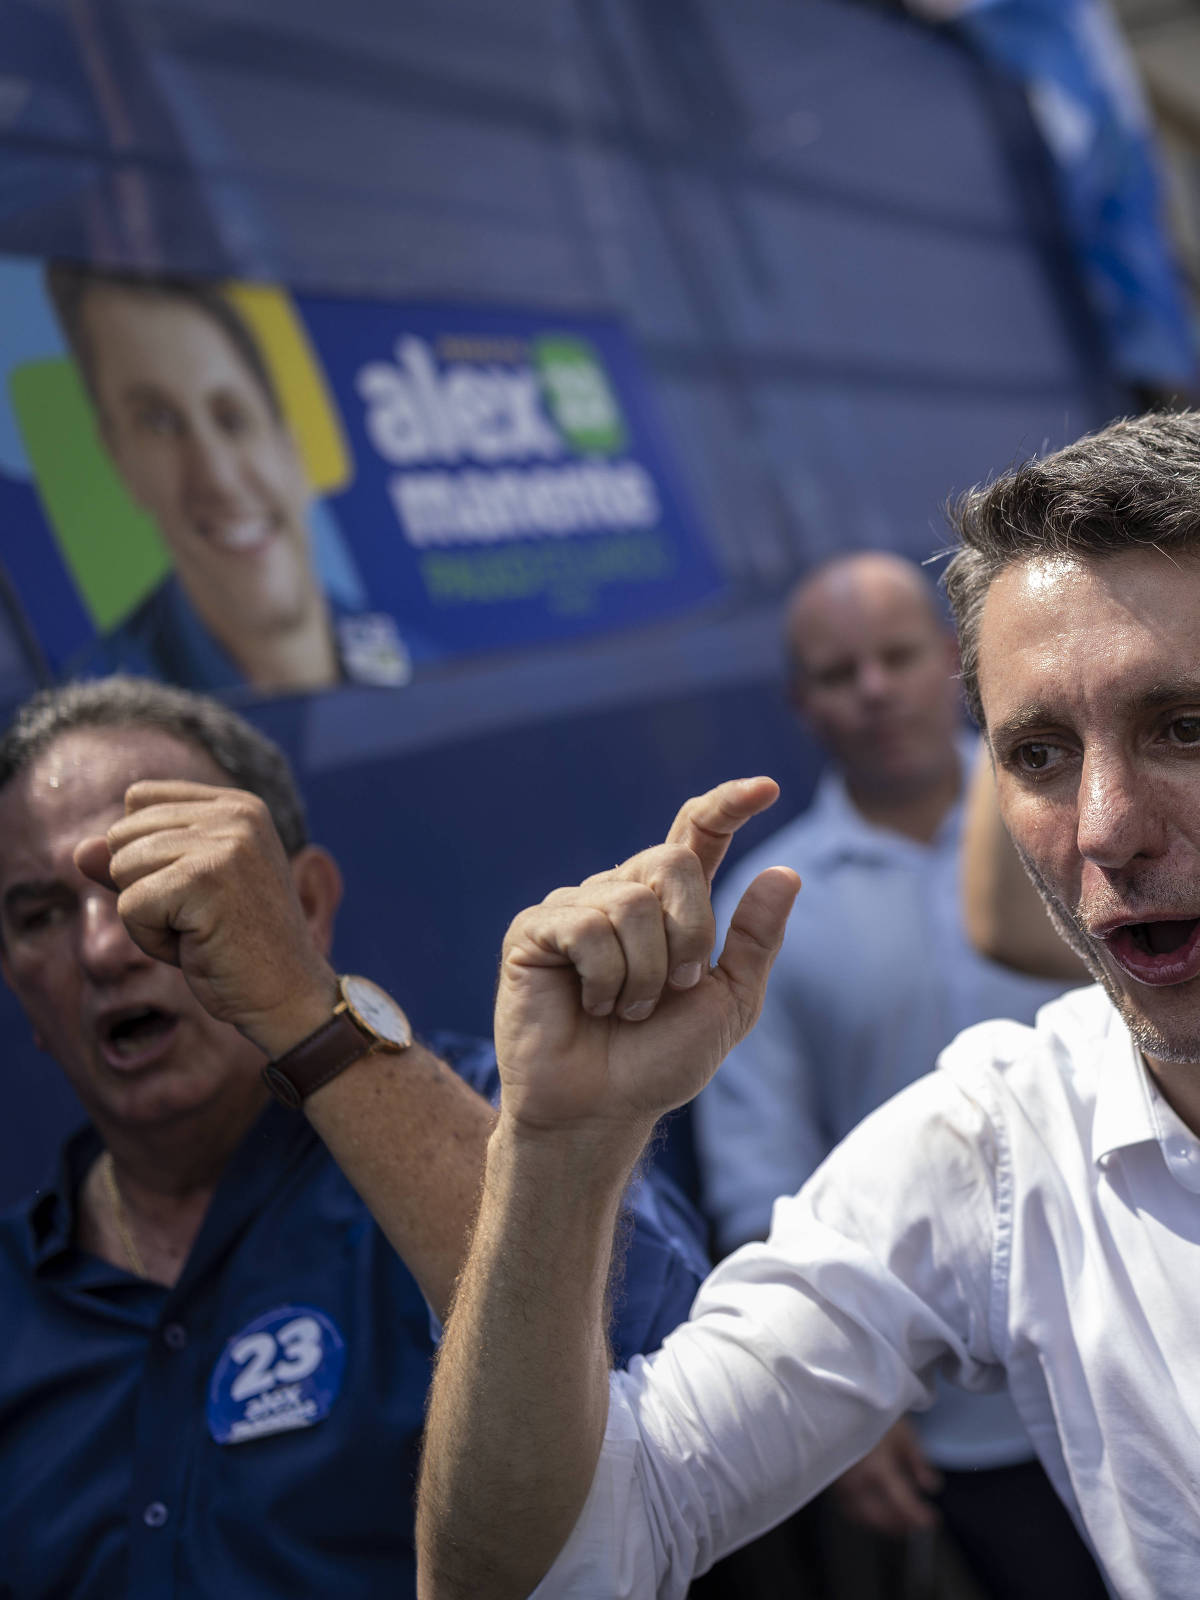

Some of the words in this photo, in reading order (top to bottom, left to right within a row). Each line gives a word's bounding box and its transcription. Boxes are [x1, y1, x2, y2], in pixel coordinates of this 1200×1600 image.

[355, 333, 562, 464] alex
[387, 459, 660, 548] manente
[230, 1316, 323, 1402] 23
